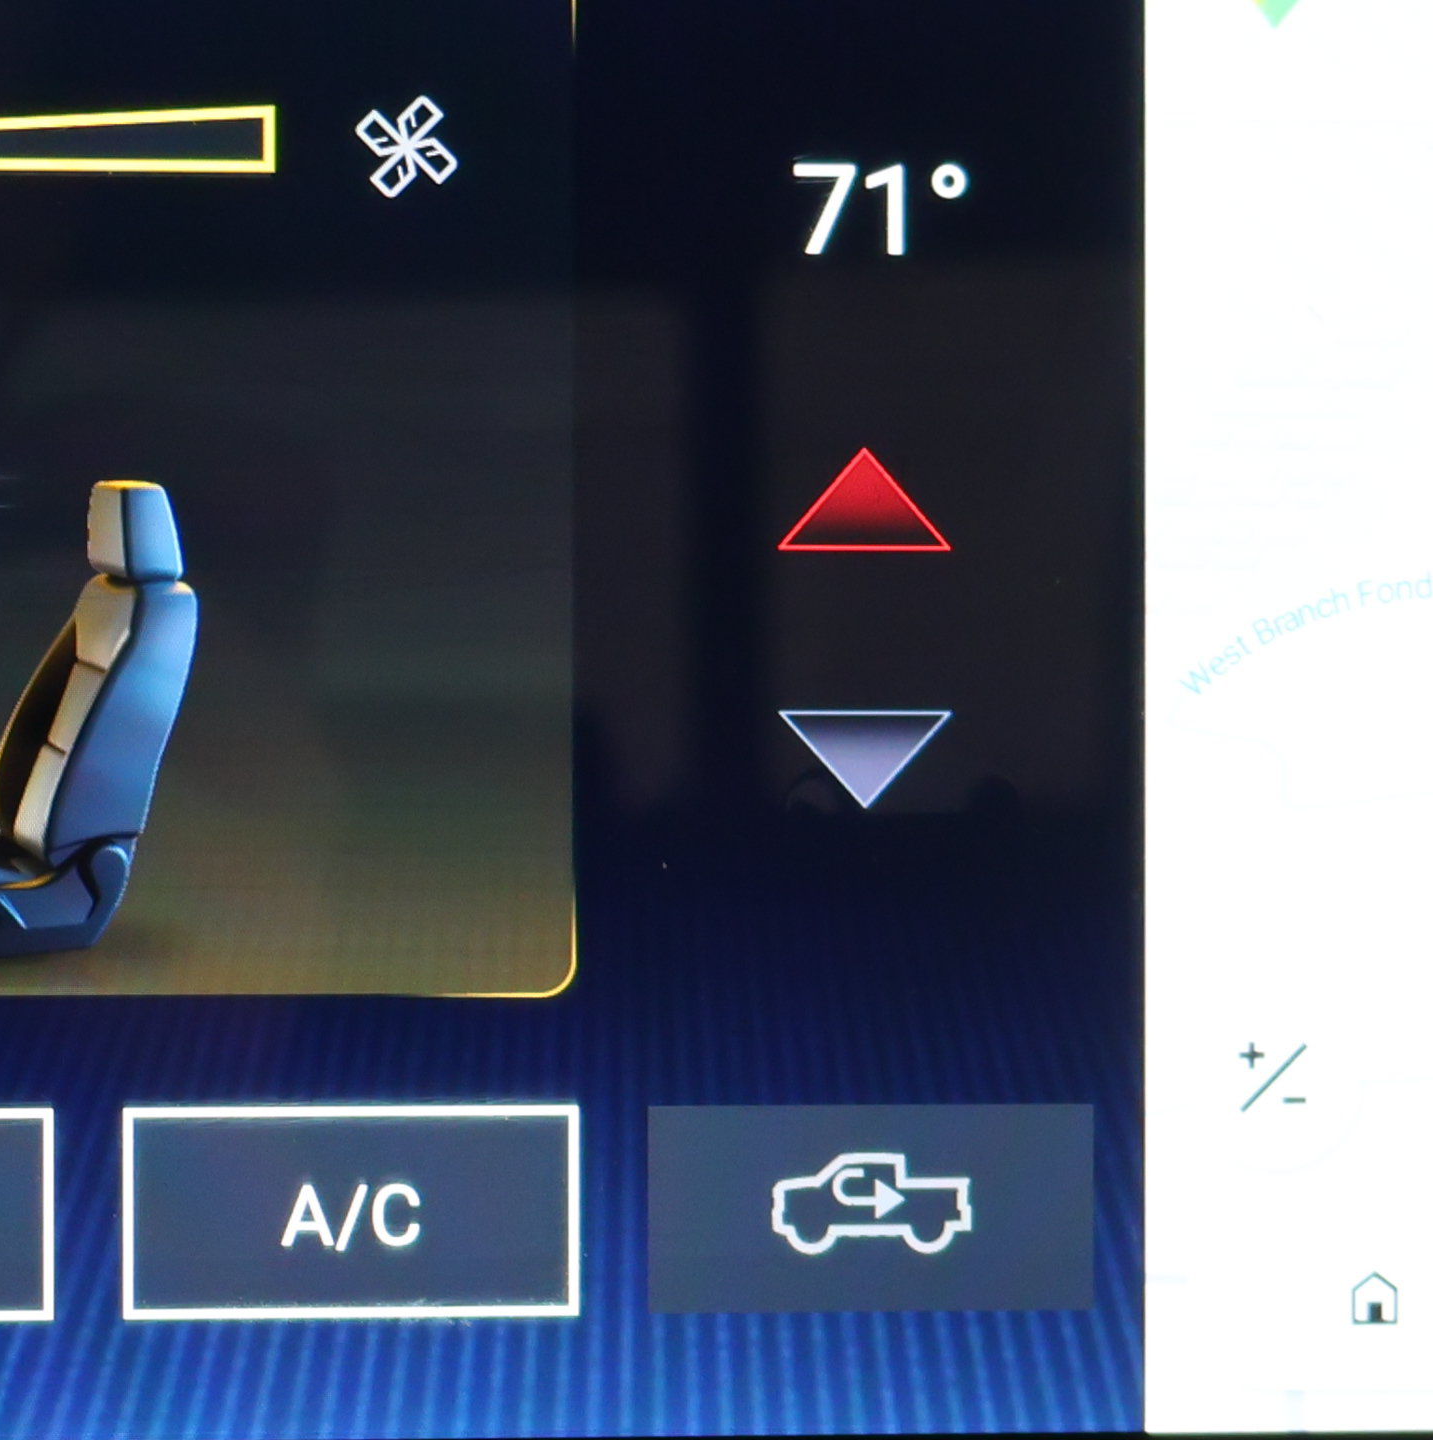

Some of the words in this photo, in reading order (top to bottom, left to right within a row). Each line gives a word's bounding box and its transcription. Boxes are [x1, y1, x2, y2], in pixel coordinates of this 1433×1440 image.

[791, 162, 969, 257] 71°
[1179, 635, 1253, 696] West
[1251, 588, 1351, 646] Branch
[1355, 571, 1433, 608] Fond
[279, 1182, 424, 1253] A/C
